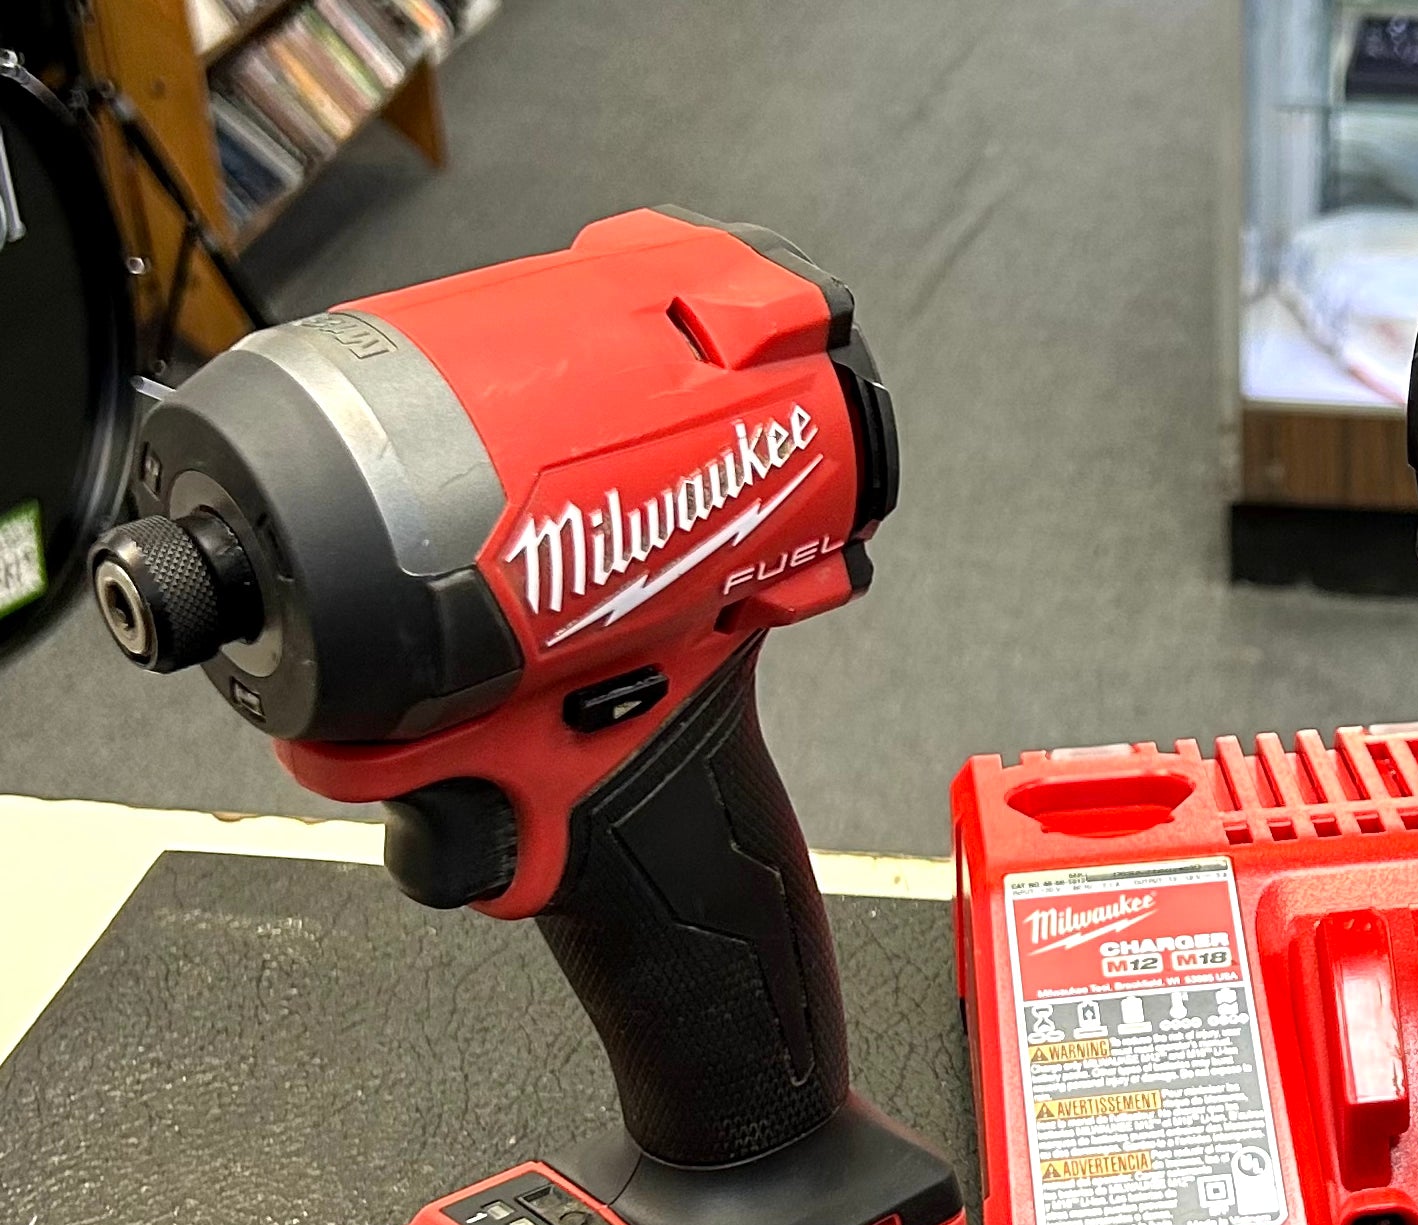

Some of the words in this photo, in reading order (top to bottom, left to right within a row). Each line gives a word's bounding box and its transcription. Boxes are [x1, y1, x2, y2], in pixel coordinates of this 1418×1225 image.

[505, 402, 819, 614] Milwaukee
[723, 534, 845, 595] FUEL
[1023, 894, 1157, 944] Milwaukee
[1099, 932, 1230, 957] CHARGER
[1107, 957, 1158, 974] M12
[1176, 951, 1228, 967] M18
[1049, 1040, 1109, 1061] WARNING
[1057, 1092, 1158, 1117] AVERTISSEMENT
[1063, 1153, 1149, 1177] ADVERTENCIA
[465, 1212, 489, 1224] 1
